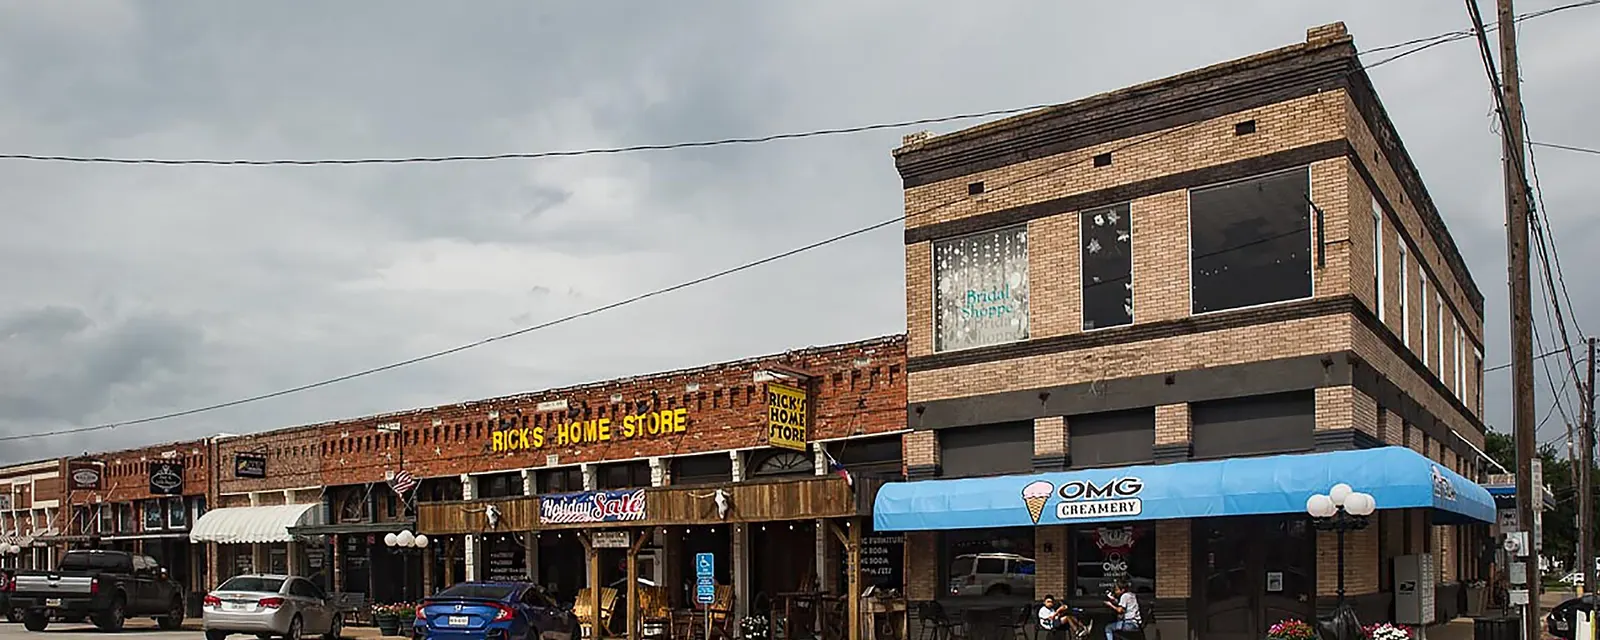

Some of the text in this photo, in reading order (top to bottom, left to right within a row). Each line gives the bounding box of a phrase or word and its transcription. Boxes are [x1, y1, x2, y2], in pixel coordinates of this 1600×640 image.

[966, 283, 1009, 304] Bridal
[961, 303, 1013, 319] Shoppe
[770, 392, 806, 412] RICK'S
[771, 408, 804, 427] HOME
[492, 407, 687, 451] RICK'S HOME STORE
[771, 424, 804, 442] STORE
[1059, 478, 1142, 499] OMG
[542, 489, 645, 520] Holiday Sale
[1062, 501, 1136, 516] CREAMERY
[1102, 561, 1128, 572] OMG
